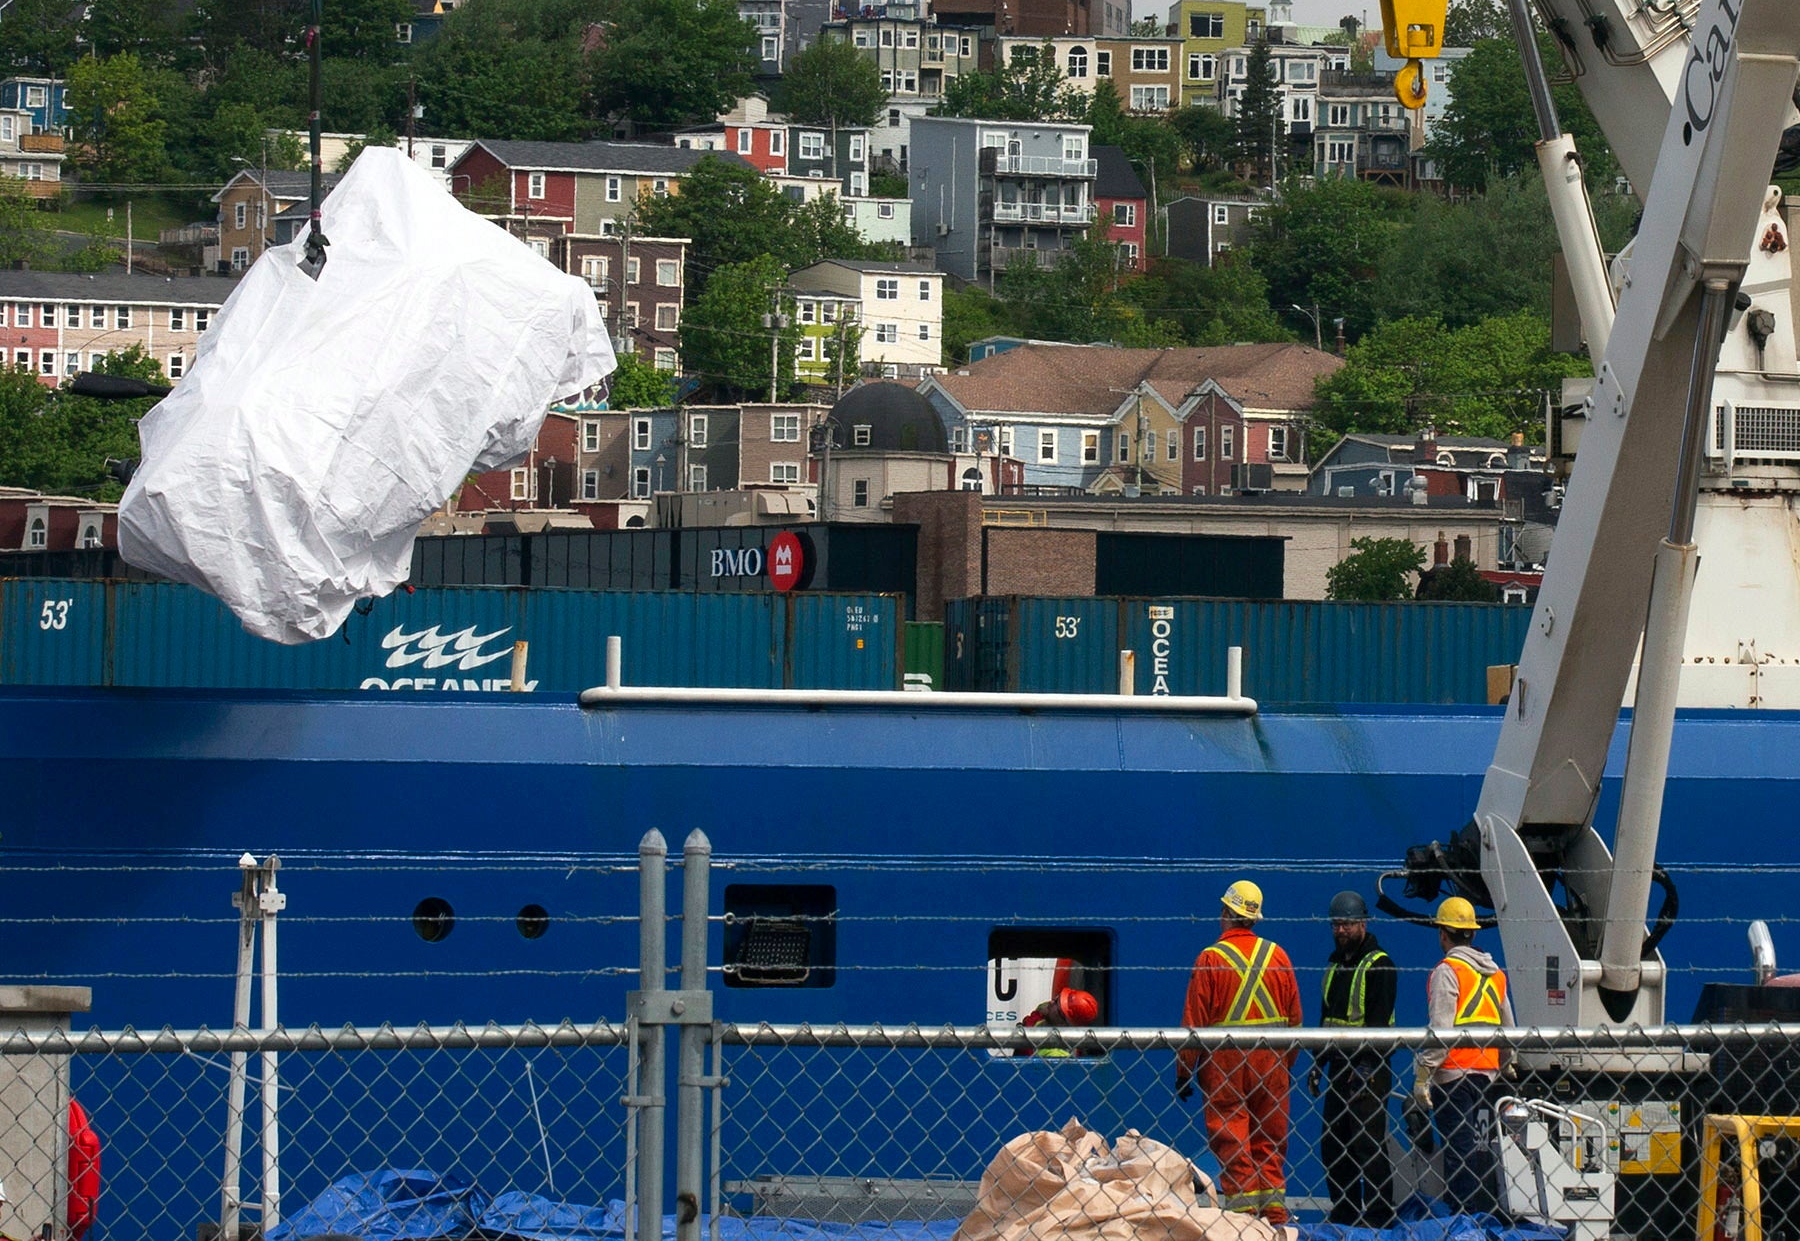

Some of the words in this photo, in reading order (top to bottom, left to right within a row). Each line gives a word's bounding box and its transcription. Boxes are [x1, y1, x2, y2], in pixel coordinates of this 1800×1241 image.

[710, 548, 762, 577] BMO
[40, 598, 73, 630] 53'
[1055, 616, 1081, 638] 53'
